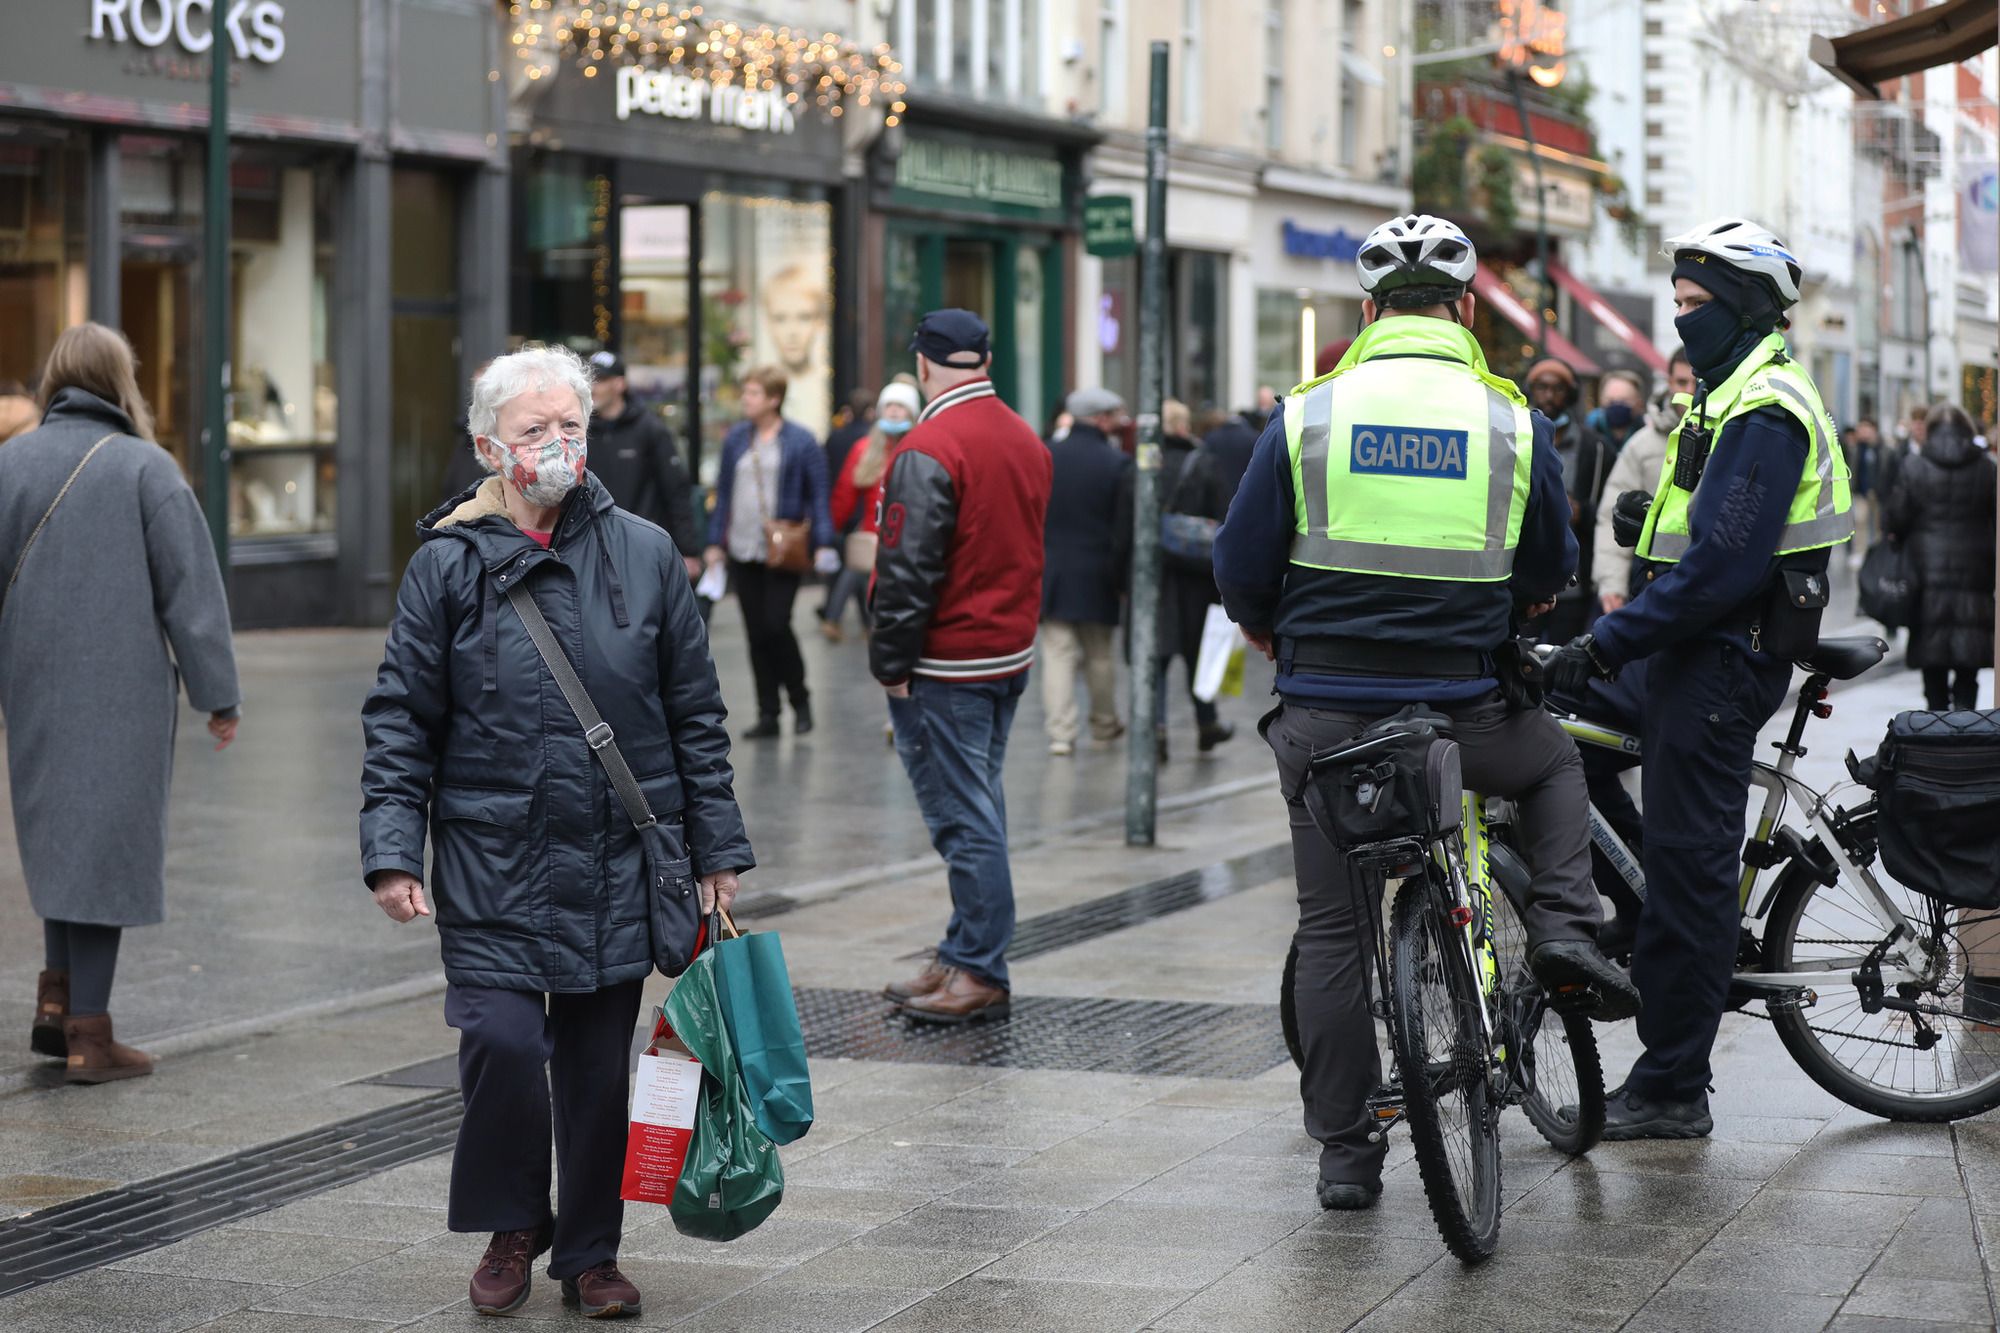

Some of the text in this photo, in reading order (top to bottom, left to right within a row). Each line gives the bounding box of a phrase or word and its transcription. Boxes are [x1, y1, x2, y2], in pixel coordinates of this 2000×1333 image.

[91, 0, 285, 63] ROCKS
[616, 65, 795, 135] peter mark
[1757, 247, 1779, 256] GARDA
[1354, 430, 1463, 472] GARDA
[883, 501, 906, 549] 9
[1590, 818, 1629, 870] CONFIDENTIAL
